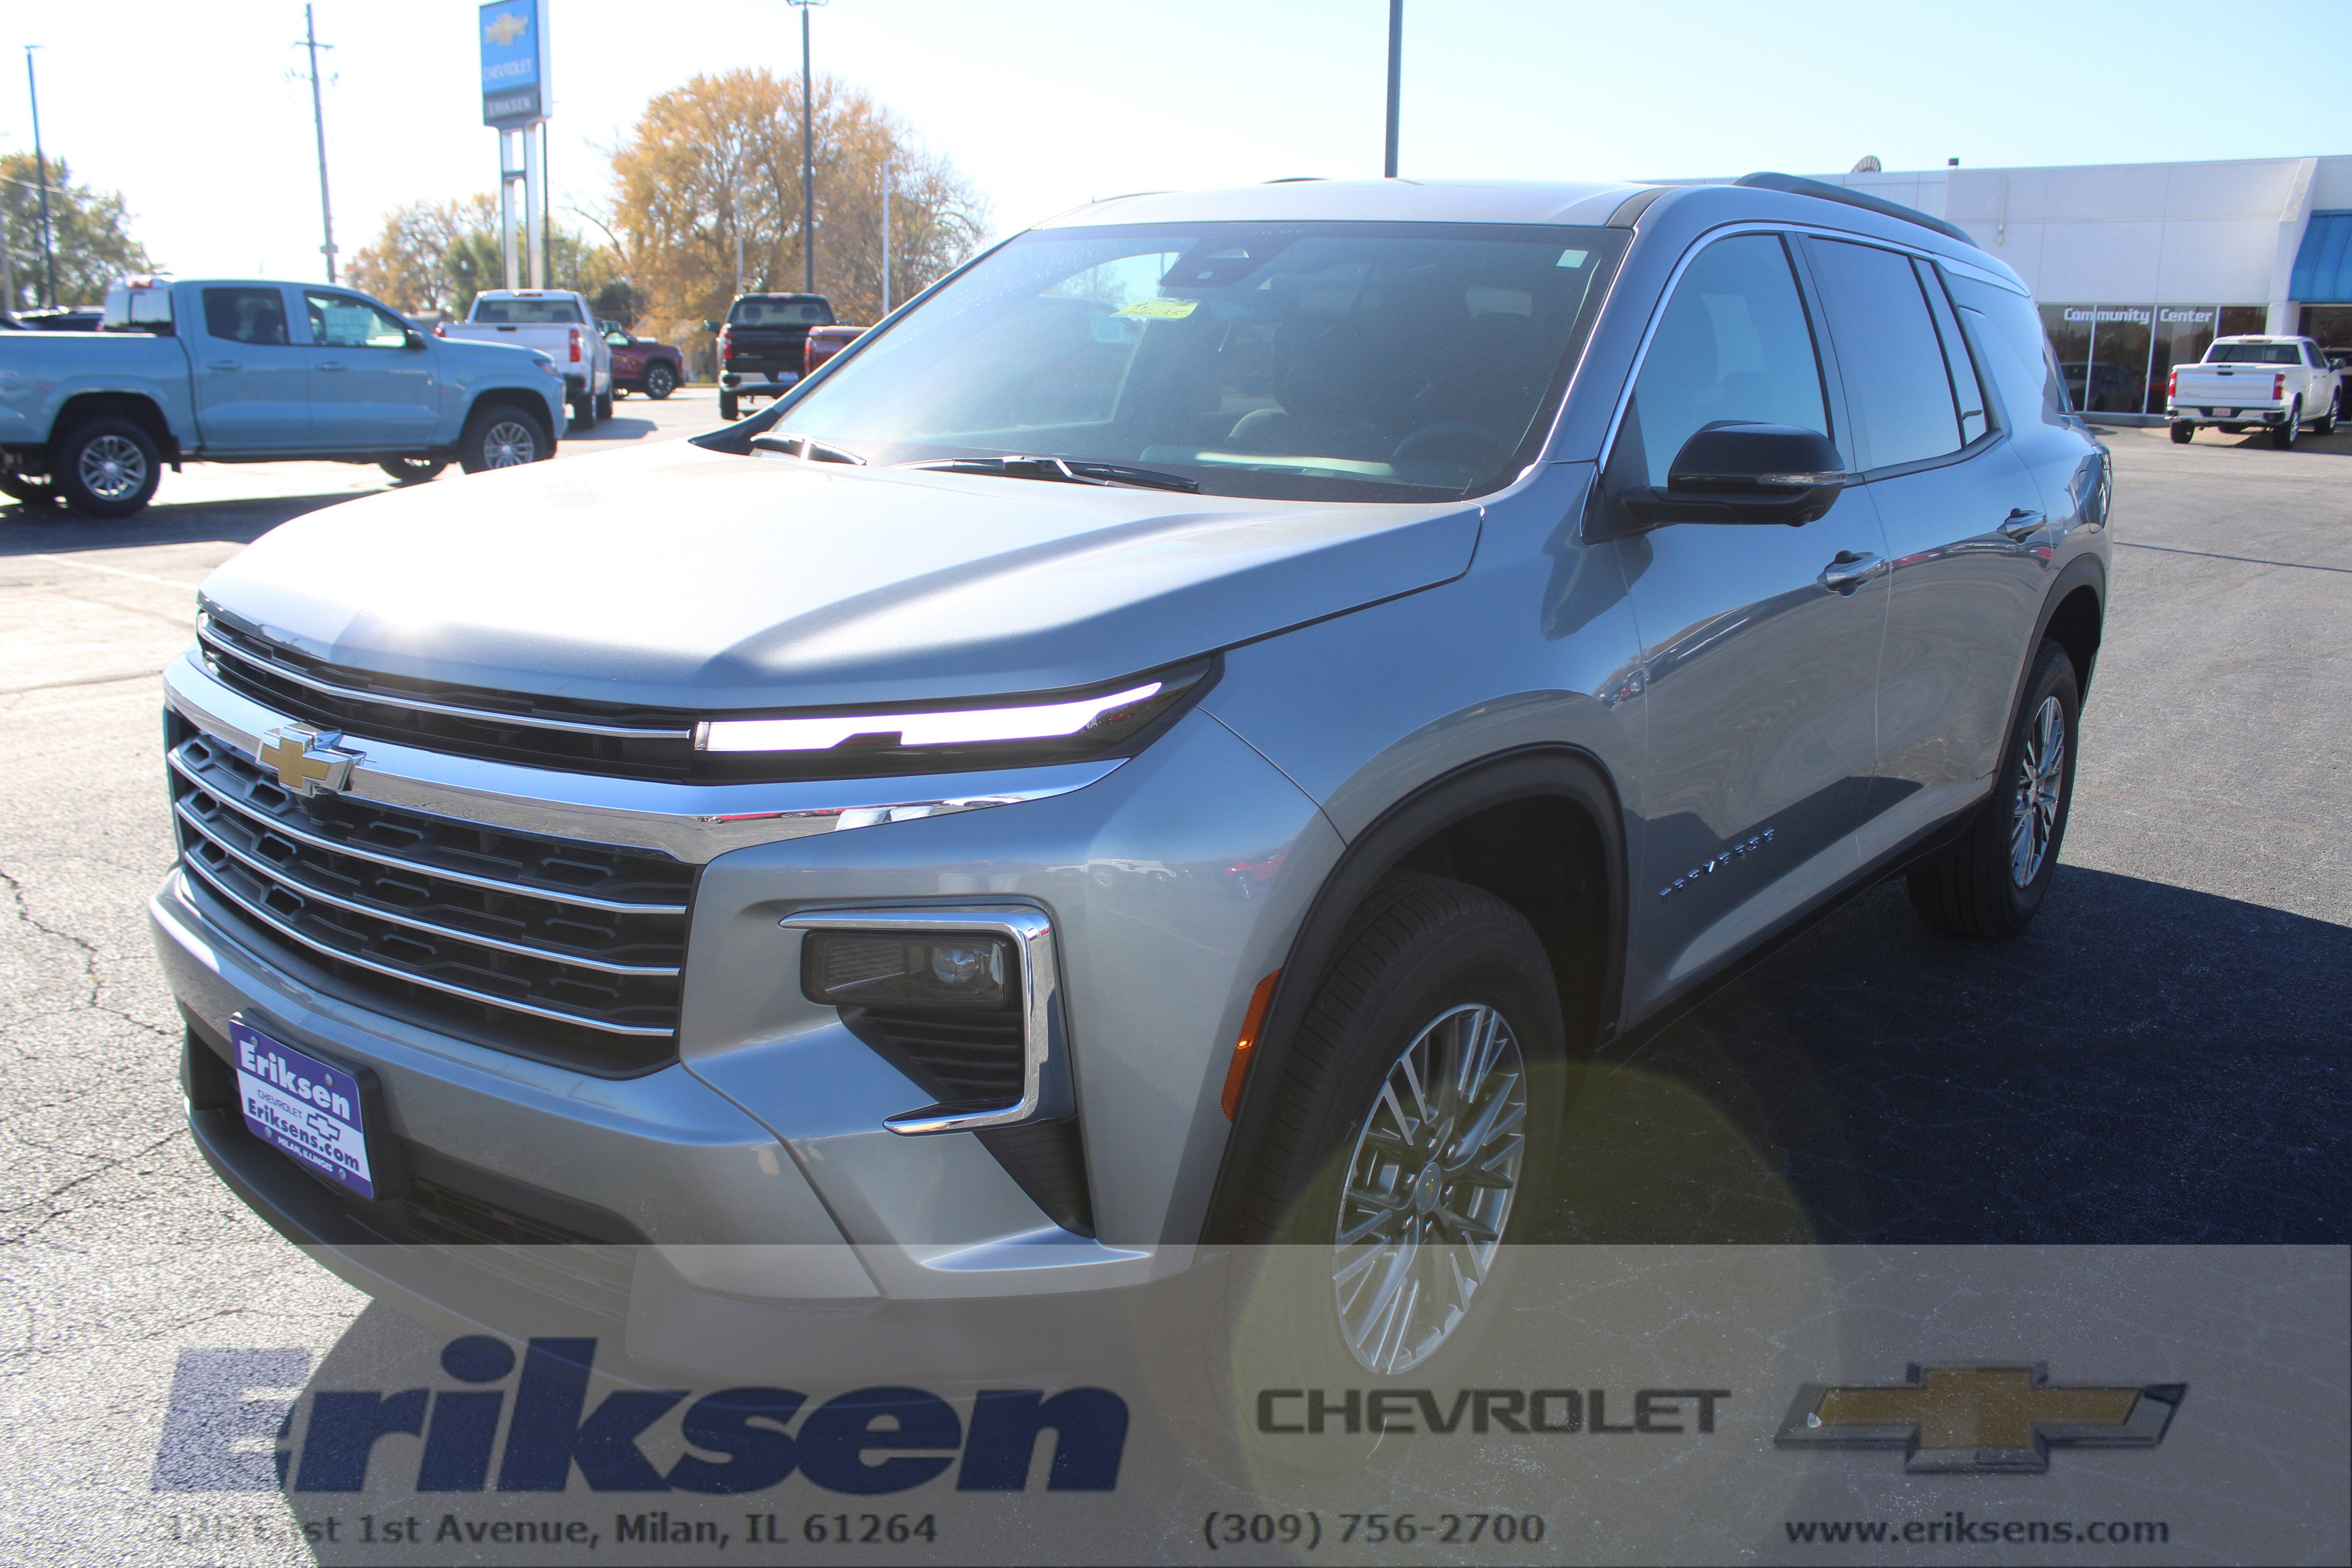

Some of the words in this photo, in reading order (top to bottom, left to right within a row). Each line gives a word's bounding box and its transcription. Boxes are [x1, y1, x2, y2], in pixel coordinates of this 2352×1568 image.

[483, 58, 531, 80] CHEVROLET
[489, 96, 530, 116] ERIKSEN
[2064, 307, 2150, 325] Community
[2160, 308, 2213, 323] Center
[239, 1040, 350, 1120] Eriksen
[257, 1089, 303, 1119] CHEVROLET
[247, 1097, 360, 1172] Eriksens.com
[302, 1149, 334, 1172] ILLINOIS
